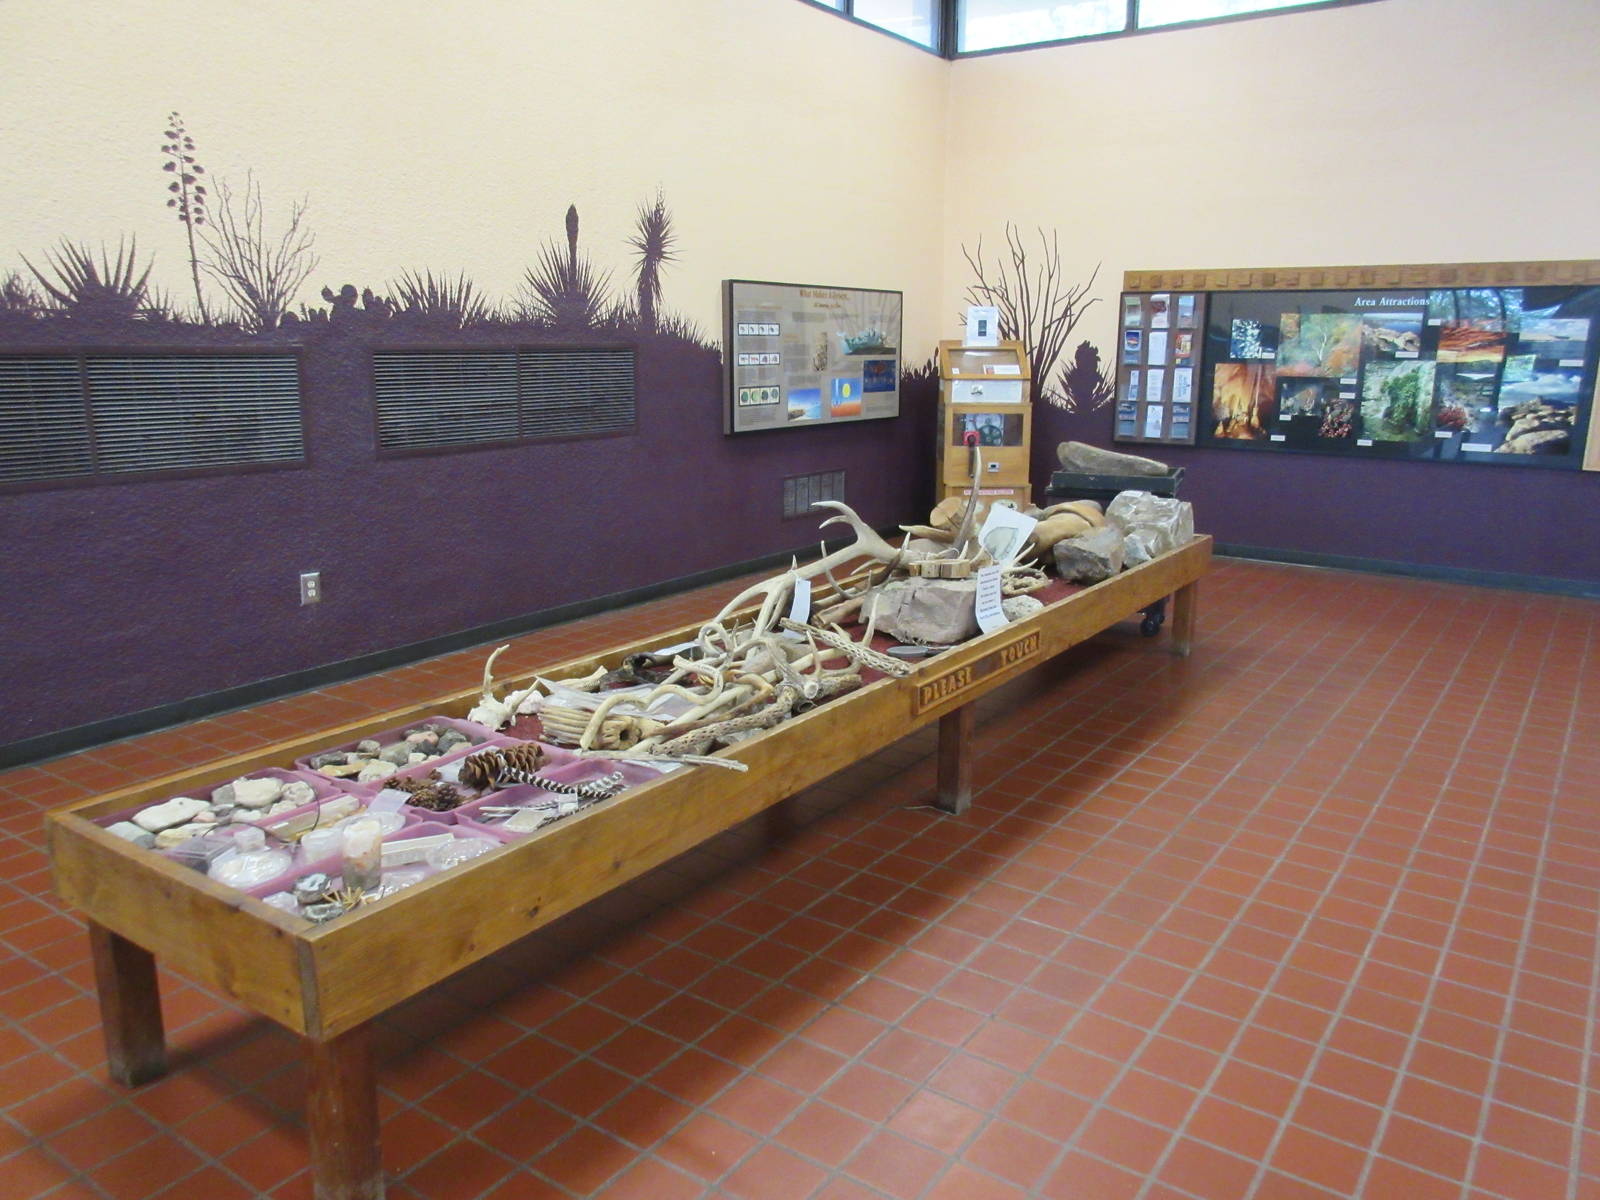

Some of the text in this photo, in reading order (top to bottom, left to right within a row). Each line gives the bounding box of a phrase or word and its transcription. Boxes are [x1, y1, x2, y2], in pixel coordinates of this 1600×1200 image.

[1354, 296, 1430, 306] Area Attractions
[922, 634, 1039, 705] PLEASE TOUCH
